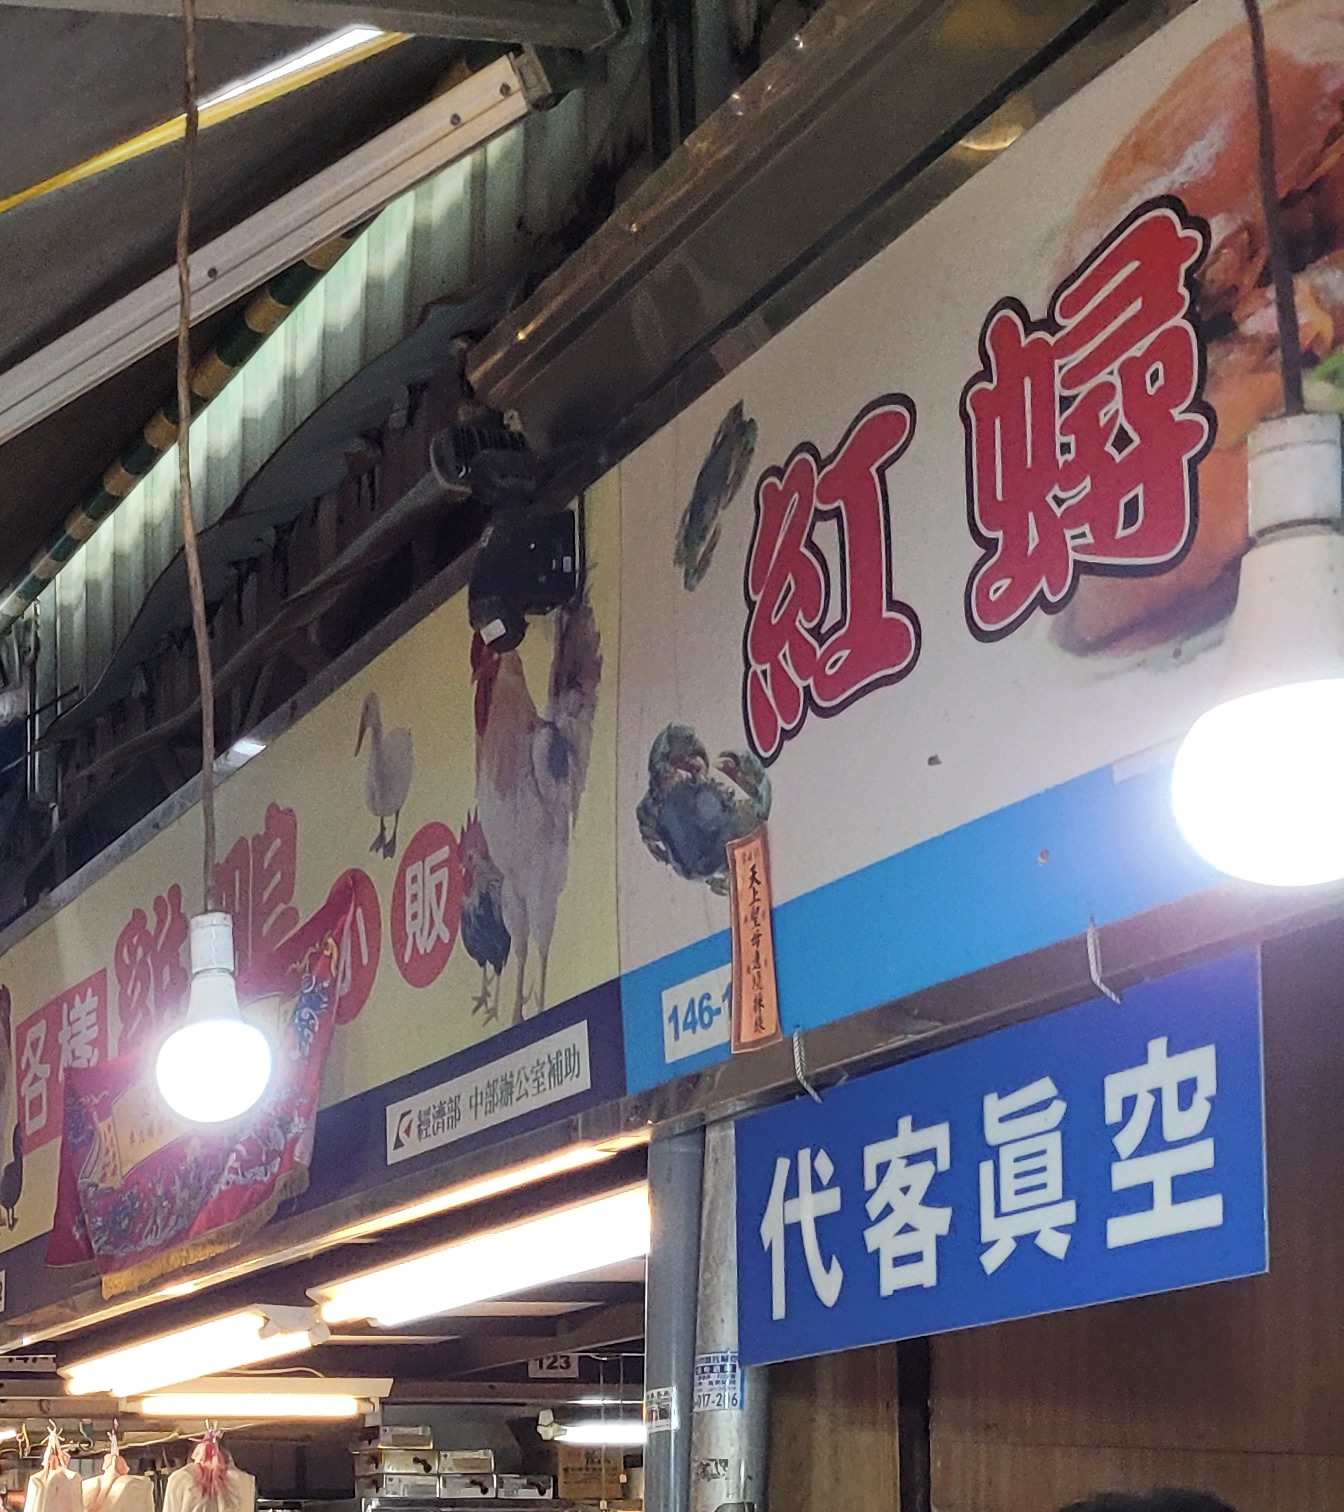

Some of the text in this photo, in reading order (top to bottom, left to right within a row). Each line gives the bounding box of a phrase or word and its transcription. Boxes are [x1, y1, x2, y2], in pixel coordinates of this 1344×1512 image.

[416, 1093, 462, 1143] 經濟部
[533, 1354, 572, 1371] 123
